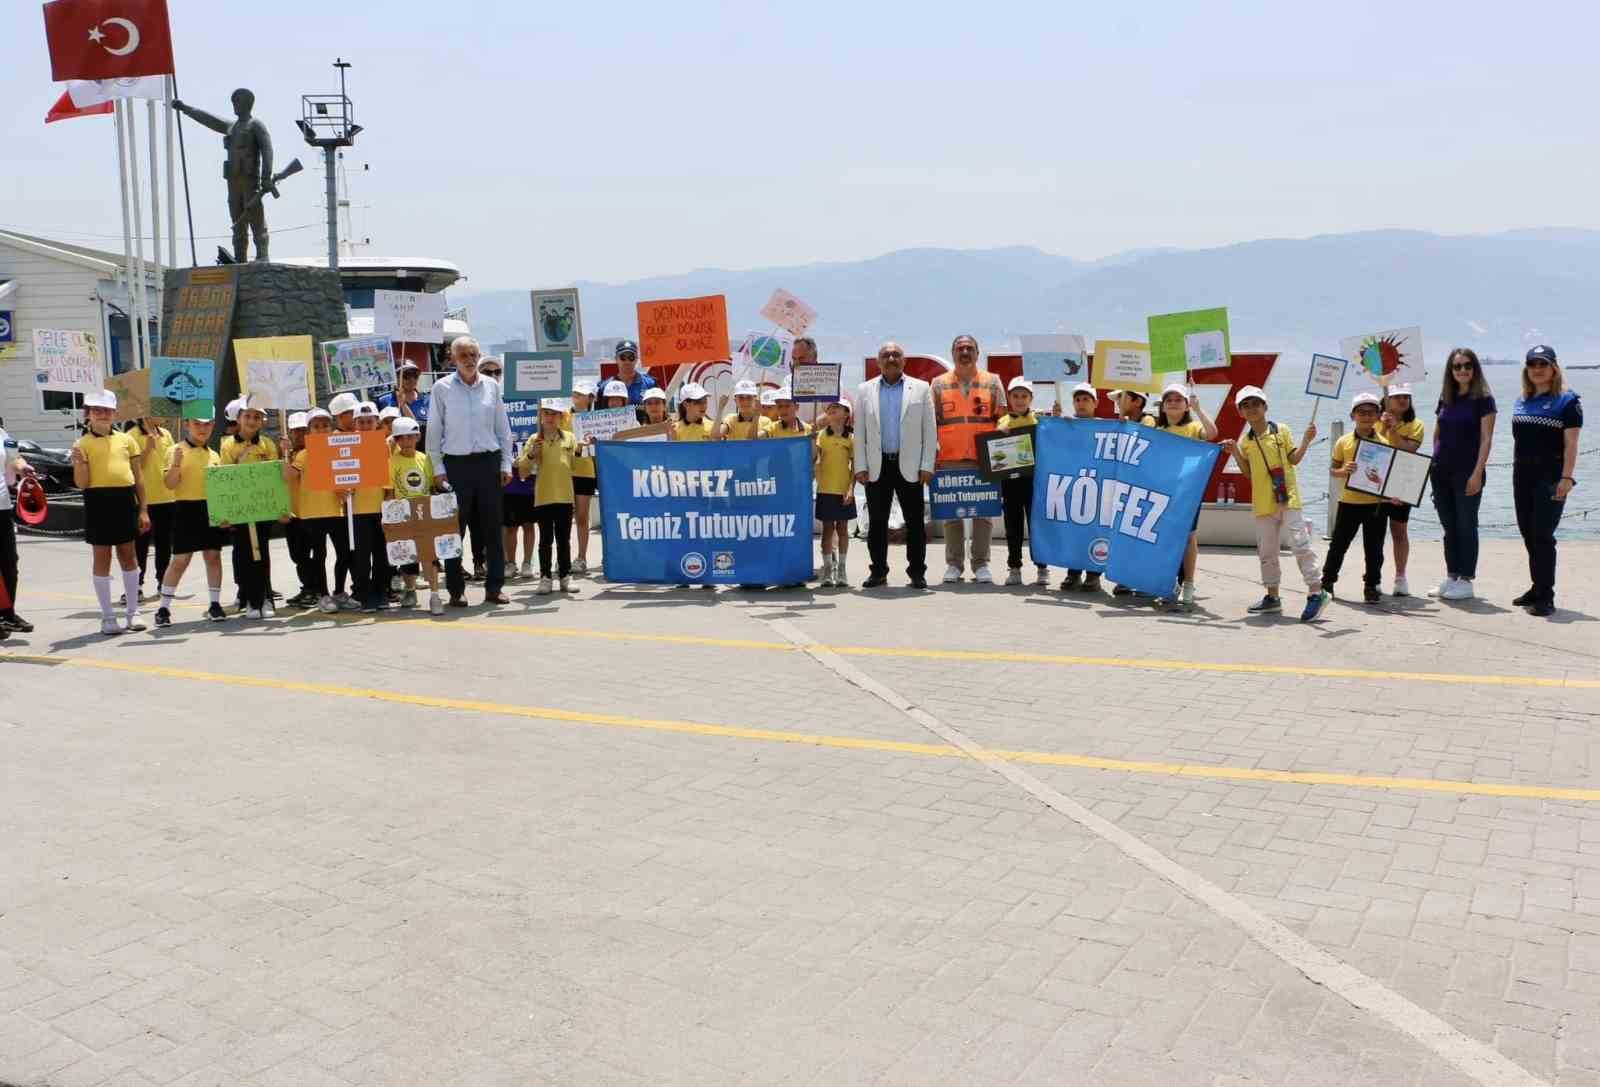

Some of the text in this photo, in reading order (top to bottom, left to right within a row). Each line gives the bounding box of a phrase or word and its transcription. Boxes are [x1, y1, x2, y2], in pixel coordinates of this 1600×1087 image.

[933, 492, 957, 504] Temiz
[617, 511, 795, 541] Temiz Tutuyoruz
